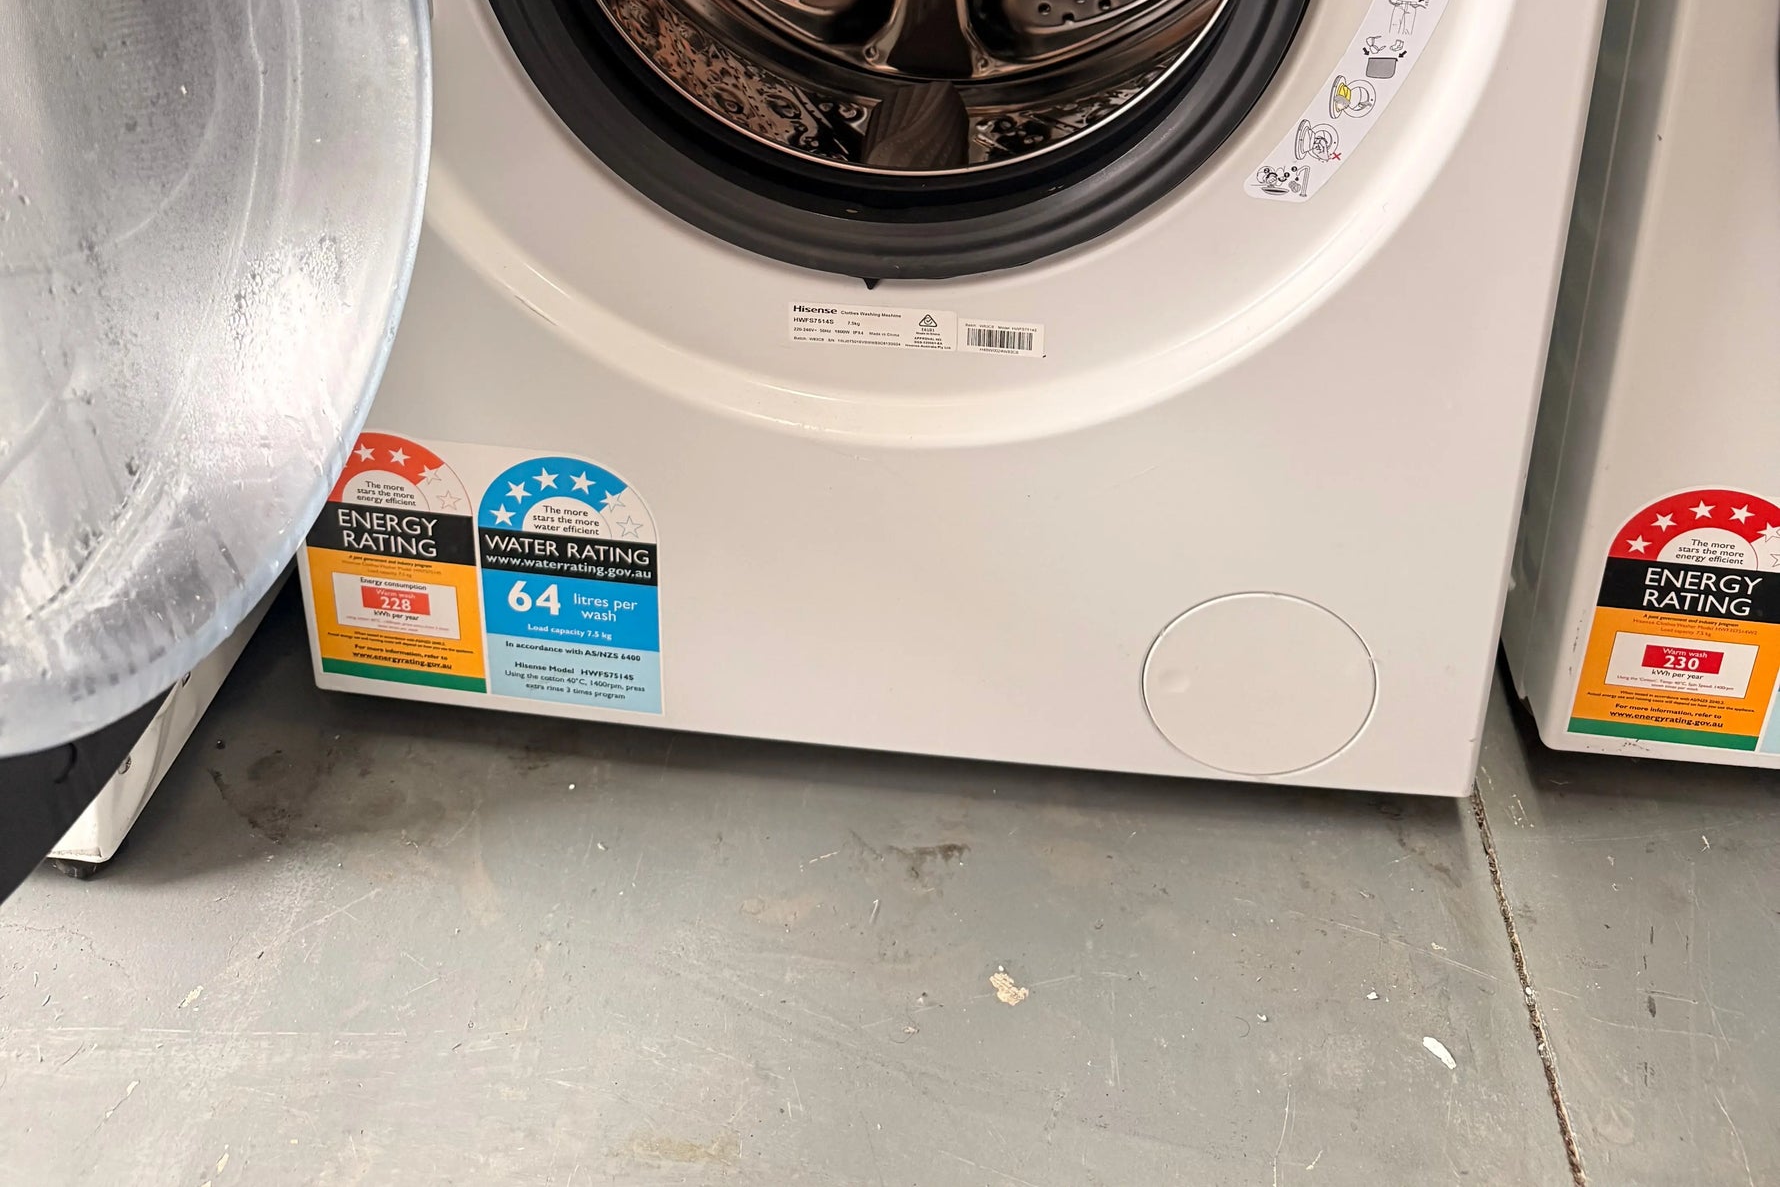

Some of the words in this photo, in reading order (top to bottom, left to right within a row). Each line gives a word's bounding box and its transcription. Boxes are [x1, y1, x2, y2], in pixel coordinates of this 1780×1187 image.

[793, 305, 838, 314] Hisense
[366, 481, 381, 489] The
[383, 484, 405, 492] more
[357, 488, 376, 496] stars
[378, 489, 391, 497] the
[393, 492, 415, 500] more
[357, 495, 383, 506] energy
[385, 497, 416, 507] efficient
[543, 505, 561, 514] The
[563, 508, 588, 517] more
[338, 508, 438, 536] ENERGY
[533, 514, 555, 523] stars
[557, 515, 573, 524] the
[575, 518, 599, 527] more
[533, 523, 561, 532] water
[563, 525, 599, 536] efficient
[343, 529, 438, 557] RATING
[484, 534, 559, 557] WATER
[567, 543, 650, 565] RATING
[1691, 539, 1709, 548] The
[1711, 542, 1735, 550] more
[1678, 546, 1701, 554] stars
[1702, 547, 1718, 556] the
[1719, 550, 1744, 558] more
[1675, 554, 1707, 564] energy
[1708, 555, 1744, 565] efficient
[486, 554, 652, 579] www.waterrating.gov.au
[360, 577, 383, 588] Energy
[385, 580, 427, 591] consumption
[1644, 567, 1763, 595] ENERGY
[376, 588, 397, 597] Warm
[399, 591, 416, 599] wash
[508, 580, 561, 616] 64
[380, 596, 412, 611] 228
[573, 593, 609, 608] litres
[613, 599, 638, 611] per
[1642, 589, 1752, 616] RATING
[393, 613, 404, 621] per
[581, 609, 617, 622] wash
[527, 623, 548, 632] Load
[551, 627, 585, 638] capacity
[602, 631, 612, 641] kg
[515, 642, 563, 653] accordance
[564, 647, 583, 655] with
[584, 649, 619, 660] AS/NZS
[621, 653, 641, 662] 6400
[1663, 647, 1687, 656] Warm
[1689, 650, 1708, 659] wash
[352, 651, 452, 670] www.energyrating.gov.au
[1663, 656, 1700, 671] 230
[514, 661, 547, 671] Hisense
[549, 665, 574, 674] Model
[1651, 668, 1670, 676] kWh
[1672, 672, 1686, 680] per
[1687, 673, 1704, 681] year
[504, 670, 525, 679] Using
[625, 685, 645, 693] press
[573, 688, 592, 696] times
[594, 690, 626, 700] program
[1609, 711, 1724, 728] www.energyrating.gov.au
